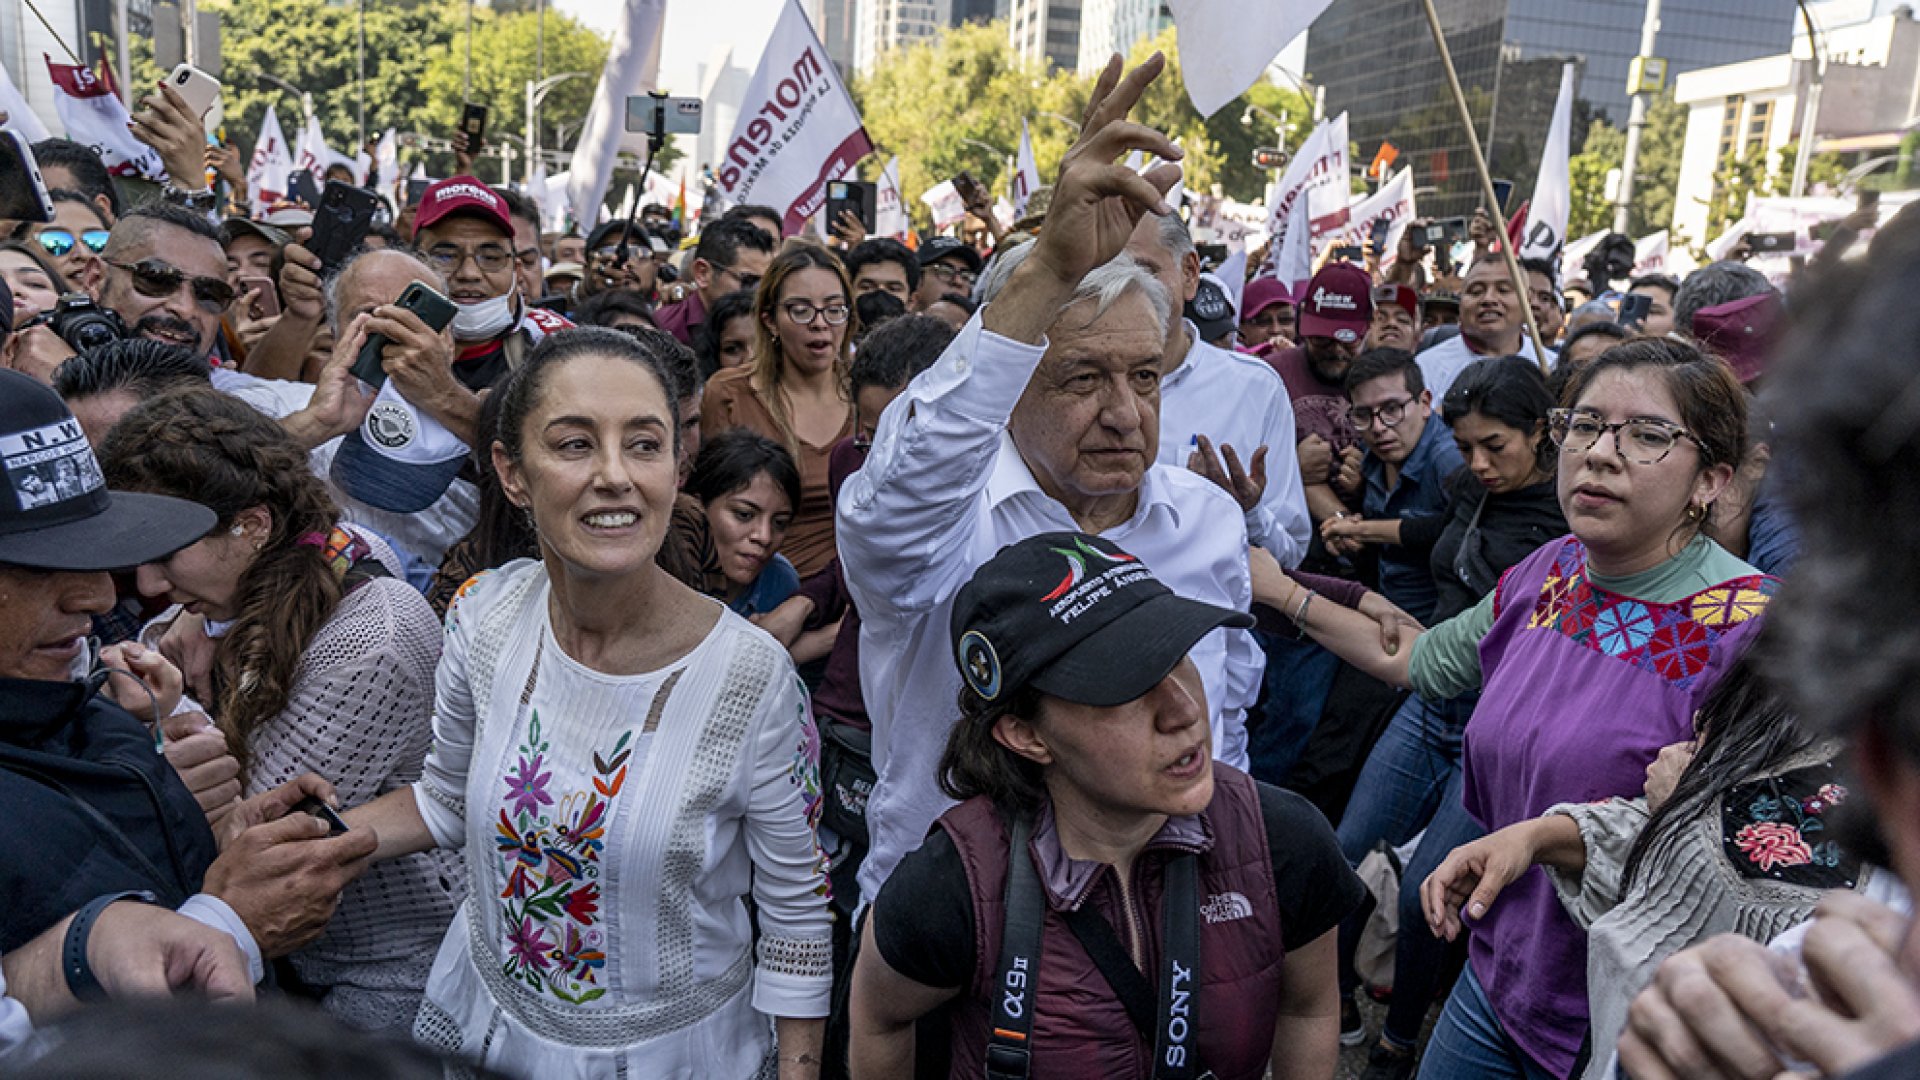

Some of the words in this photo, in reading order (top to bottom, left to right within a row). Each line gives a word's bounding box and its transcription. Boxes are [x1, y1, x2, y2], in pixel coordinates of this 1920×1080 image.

[435, 183, 498, 207] morena
[1061, 586, 1112, 624] FELIPE
[1166, 959, 1192, 1068] SONY
